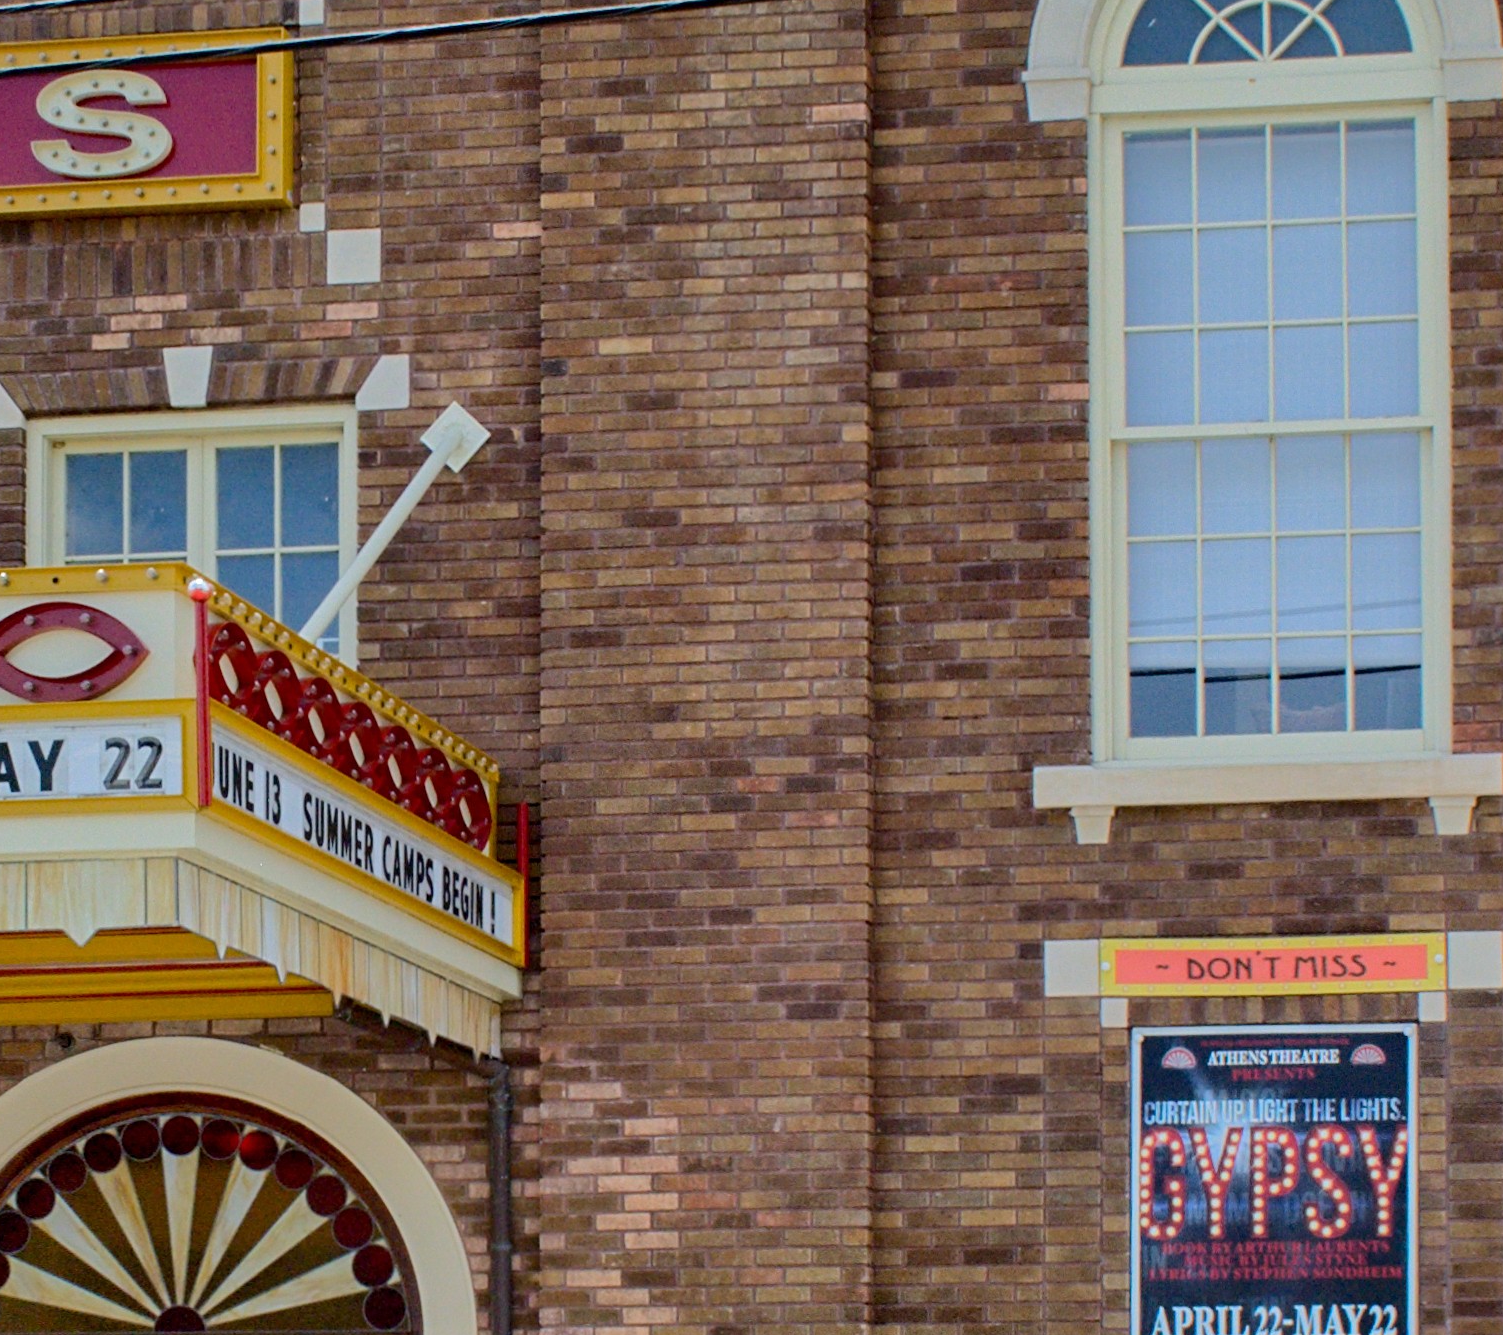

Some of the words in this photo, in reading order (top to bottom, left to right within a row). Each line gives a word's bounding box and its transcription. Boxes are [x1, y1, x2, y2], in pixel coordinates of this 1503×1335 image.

[103, 736, 164, 790] 22
[265, 770, 282, 825] 13
[303, 792, 374, 874] SUMMER
[382, 835, 434, 904] CAMPS
[442, 866, 484, 929] BEGIN
[1187, 950, 1280, 980] DON'T
[1294, 954, 1367, 979] MISS
[1231, 1068, 1316, 1082] PRESENTS
[1144, 1100, 1217, 1126] CURTAIN
[1249, 1098, 1298, 1123] LIGHT
[1303, 1097, 1336, 1122] THE
[1140, 1124, 1407, 1241] GYPSY
[1162, 1241, 1208, 1255] BOOK
[1212, 1241, 1233, 1254] BY
[1235, 1240, 1301, 1254] ARTHUR
[1304, 1239, 1391, 1253] LAURENTS
[1233, 1267, 1308, 1280] STEPHEN
